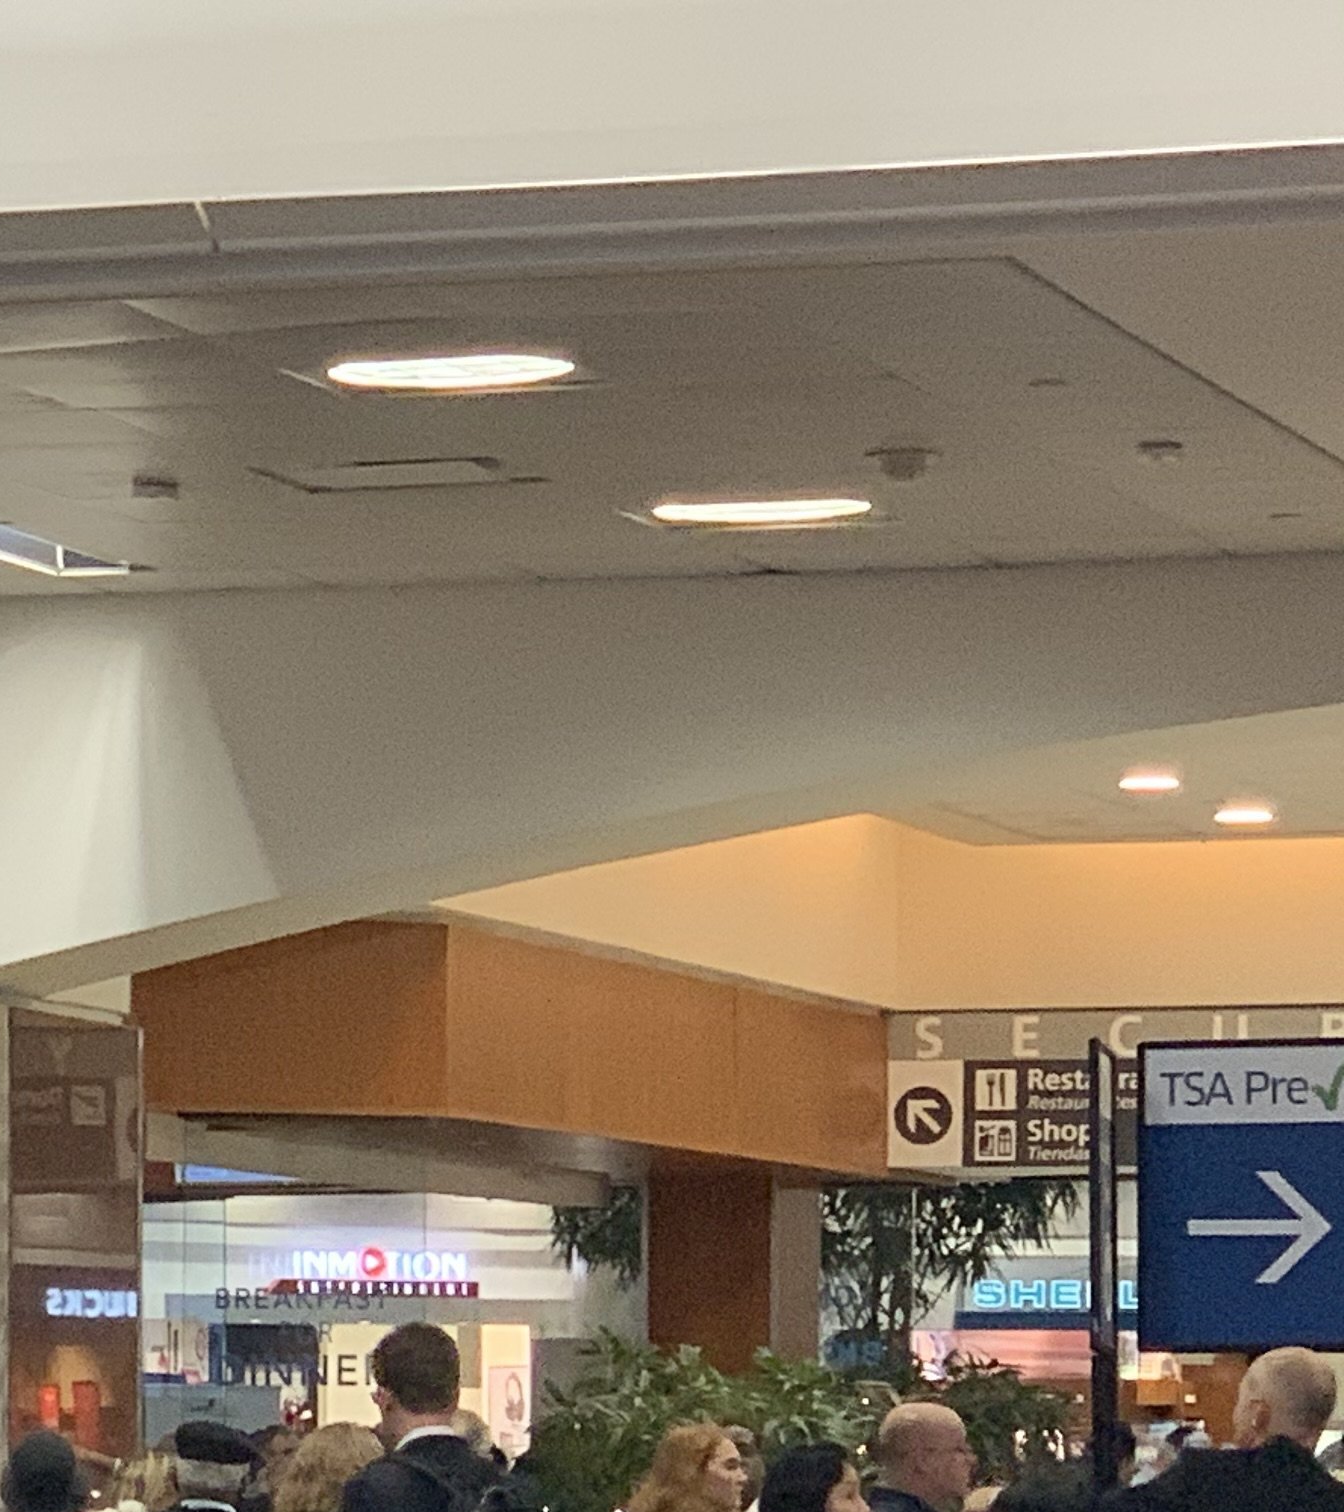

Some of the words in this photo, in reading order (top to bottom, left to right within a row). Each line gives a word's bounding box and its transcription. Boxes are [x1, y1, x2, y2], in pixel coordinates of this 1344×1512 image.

[1160, 1071, 1233, 1106] TSA
[1245, 1071, 1309, 1105] Pre
[293, 1248, 467, 1278] INMOTION
[215, 1287, 387, 1310] BREAKFAST
[973, 1279, 1138, 1310] SHEL
